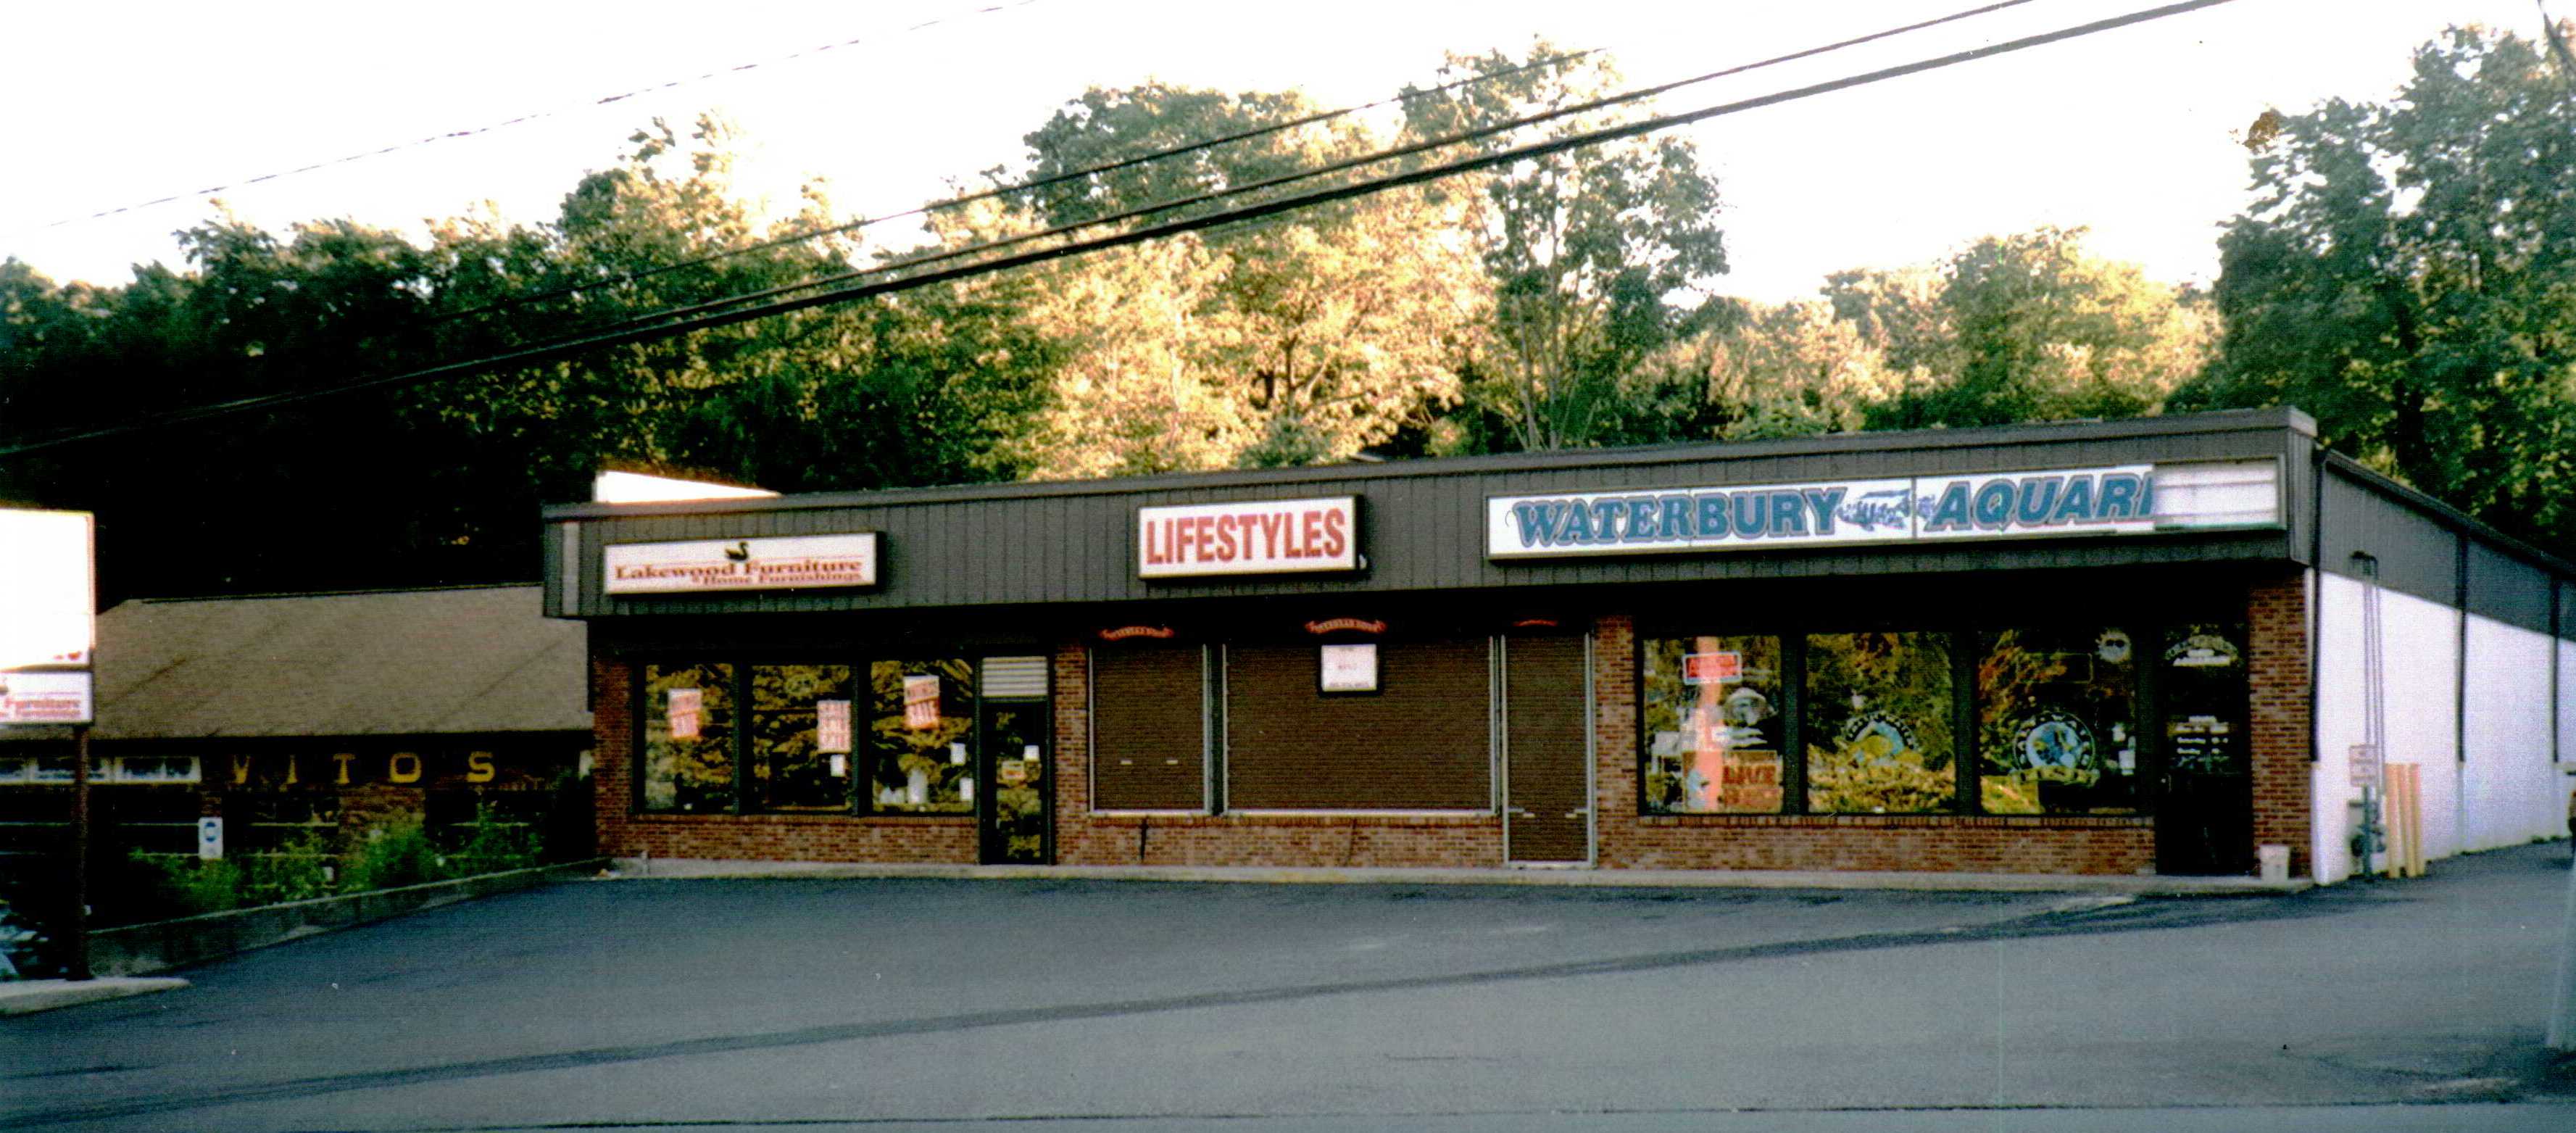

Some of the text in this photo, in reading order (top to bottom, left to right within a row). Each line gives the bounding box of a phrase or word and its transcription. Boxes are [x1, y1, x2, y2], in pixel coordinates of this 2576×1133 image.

[1513, 486, 1848, 548] WATERBURY
[1146, 507, 1345, 564] LIFESTYLES
[615, 559, 861, 579] Lakewood Furniture
[702, 575, 750, 585] Home
[759, 572, 861, 584] Furnishings
[233, 751, 496, 784] VITOS
